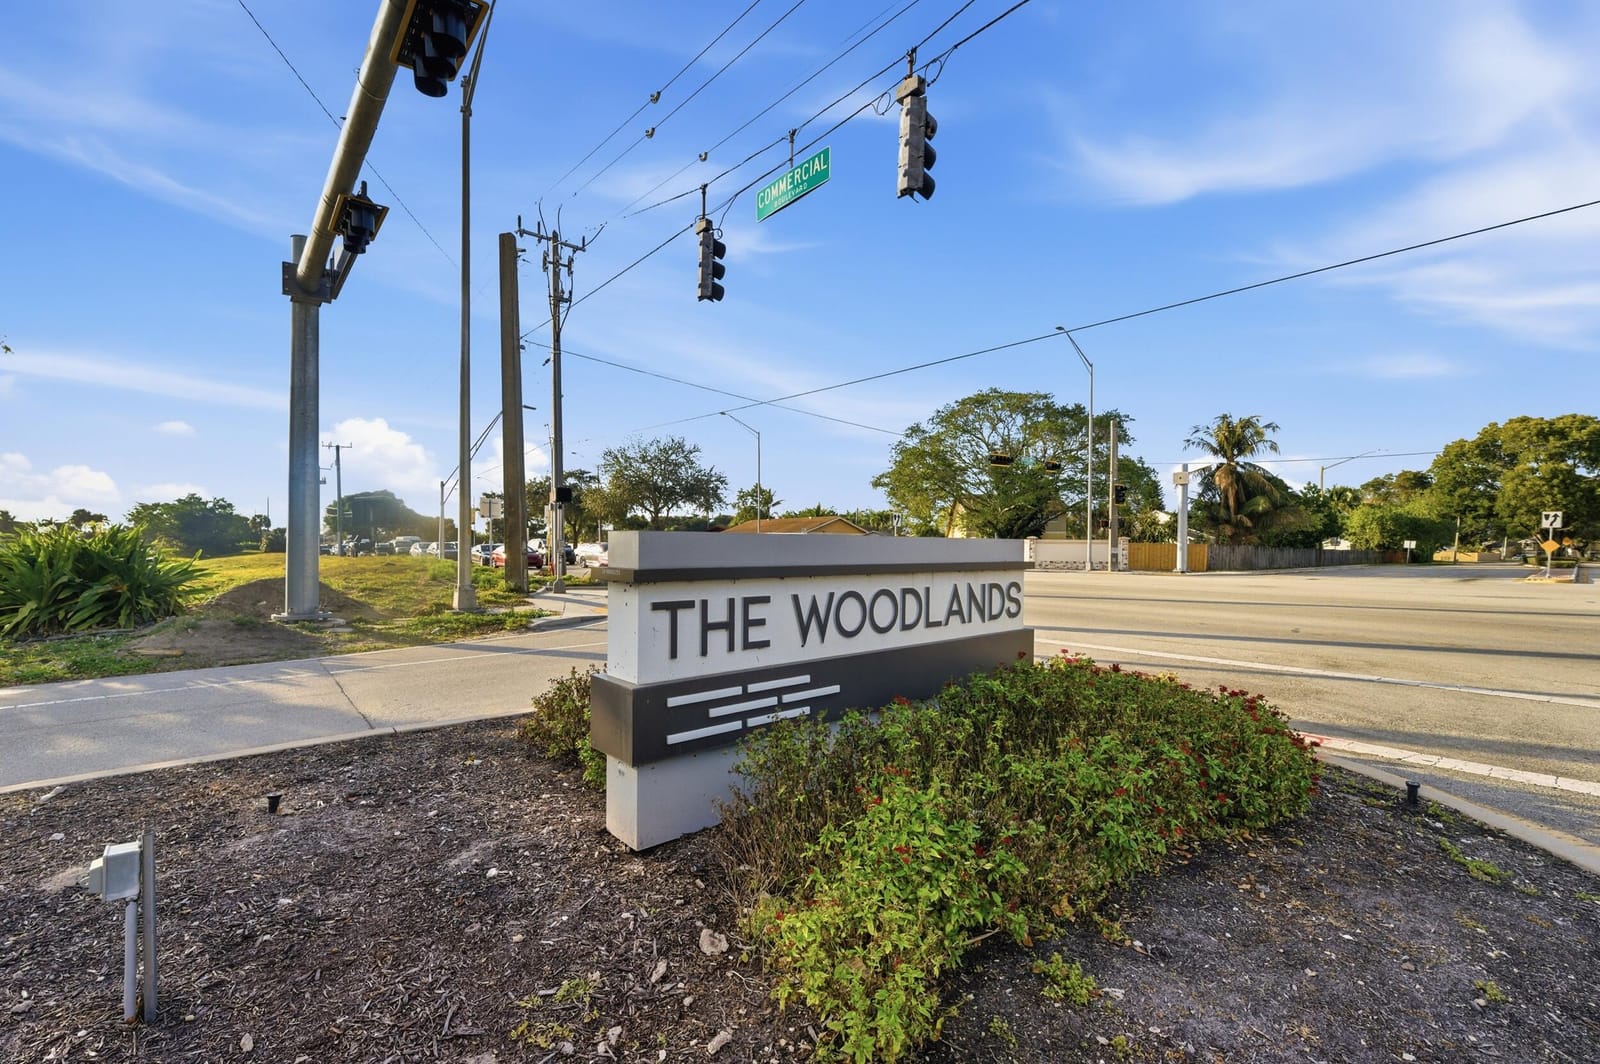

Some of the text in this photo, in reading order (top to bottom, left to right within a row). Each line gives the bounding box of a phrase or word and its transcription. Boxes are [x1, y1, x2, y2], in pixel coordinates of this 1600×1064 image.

[758, 153, 828, 209] COMMERCIAL
[774, 182, 808, 208] BOULEVARD
[651, 581, 1022, 660] THE WOODLANDS
